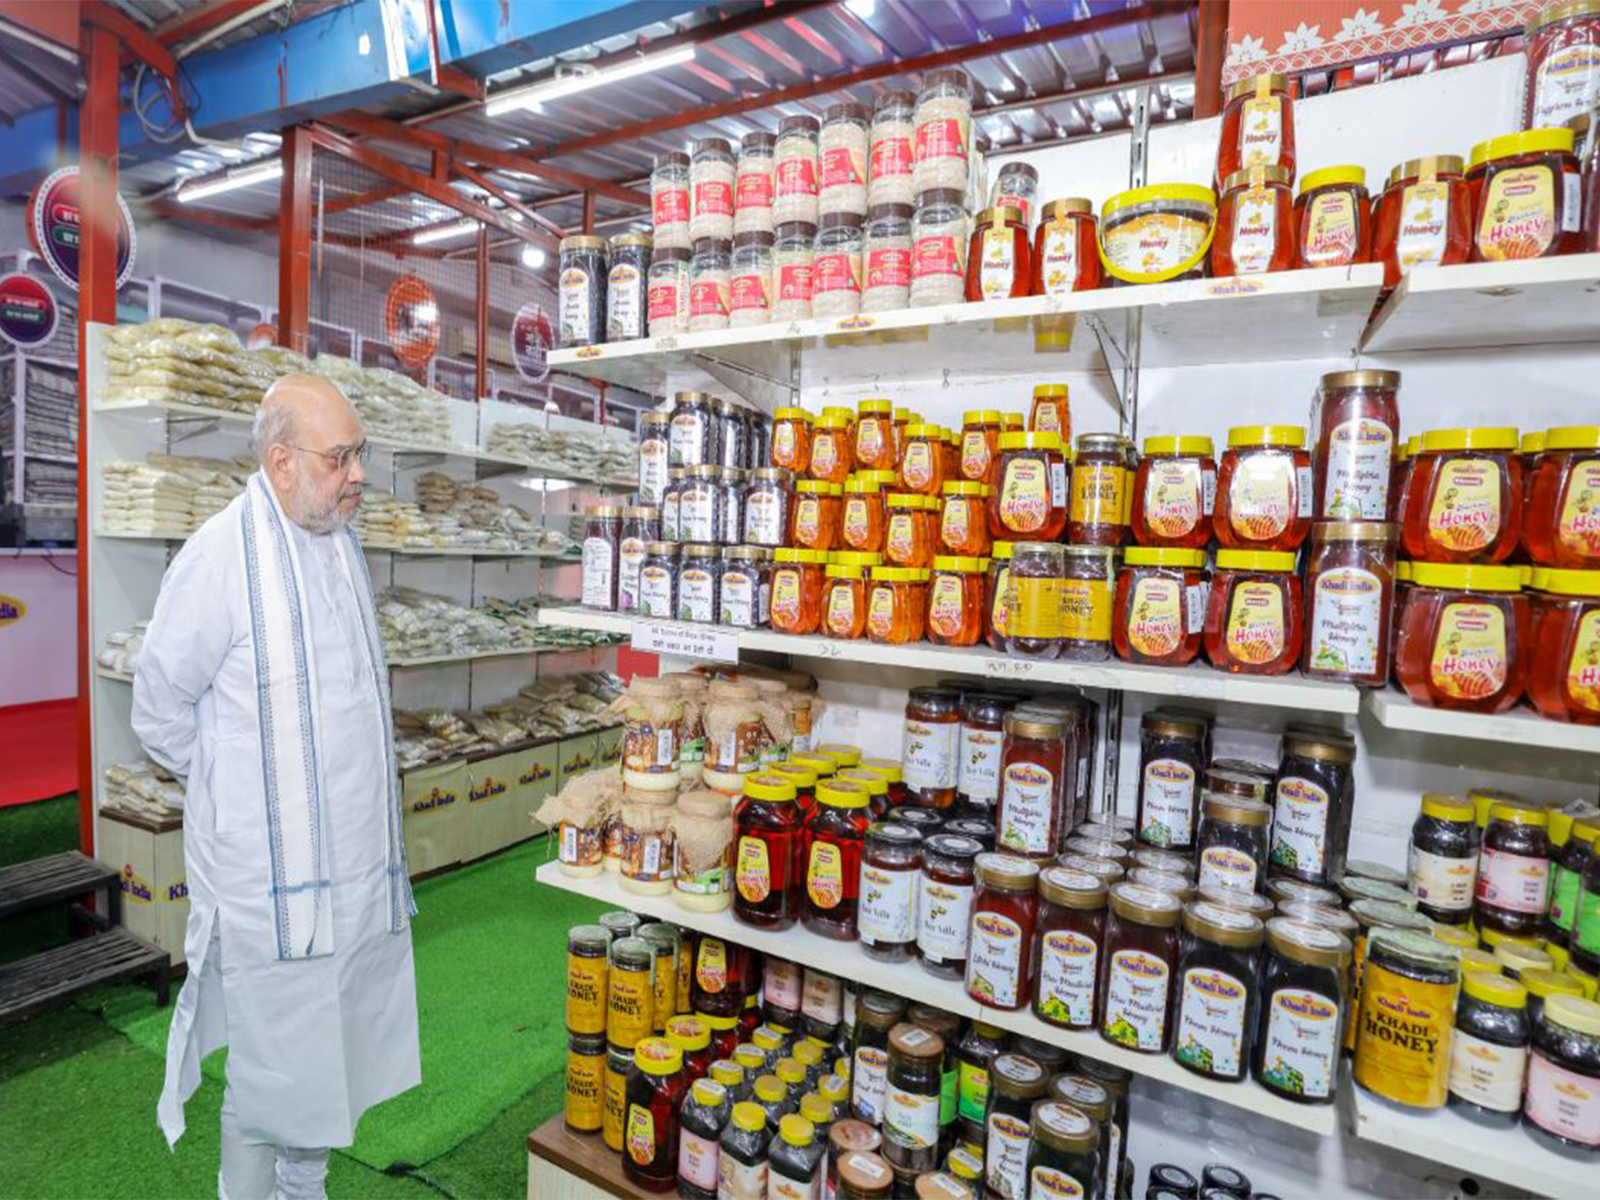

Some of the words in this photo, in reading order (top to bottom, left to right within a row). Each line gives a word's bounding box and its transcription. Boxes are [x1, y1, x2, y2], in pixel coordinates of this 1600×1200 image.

[1245, 133, 1277, 145] Honey
[1240, 226, 1269, 236] Honey
[1403, 223, 1443, 237] Honey
[1489, 220, 1544, 243] Honey
[1140, 239, 1168, 249] Honey
[984, 259, 1010, 270] Honey
[1048, 254, 1071, 263] Honey
[1337, 431, 1362, 441] Khdi
[1007, 499, 1041, 513] Honey
[1439, 510, 1489, 526] Honey
[1136, 622, 1174, 635] Honey
[1235, 627, 1276, 642] Honey
[1443, 657, 1496, 674] Honey
[1049, 939, 1070, 951] Khadi
[1118, 958, 1142, 972] Khadi
[1191, 977, 1216, 991] Khadi
[1217, 986, 1238, 997] India
[1280, 997, 1306, 1012] Khadi
[1308, 1006, 1331, 1018] India
[1378, 997, 1404, 1013] Khadi
[1406, 1007, 1430, 1019] India
[1376, 1012, 1429, 1037] KHADI
[1365, 1019, 1438, 1054] HONEY
